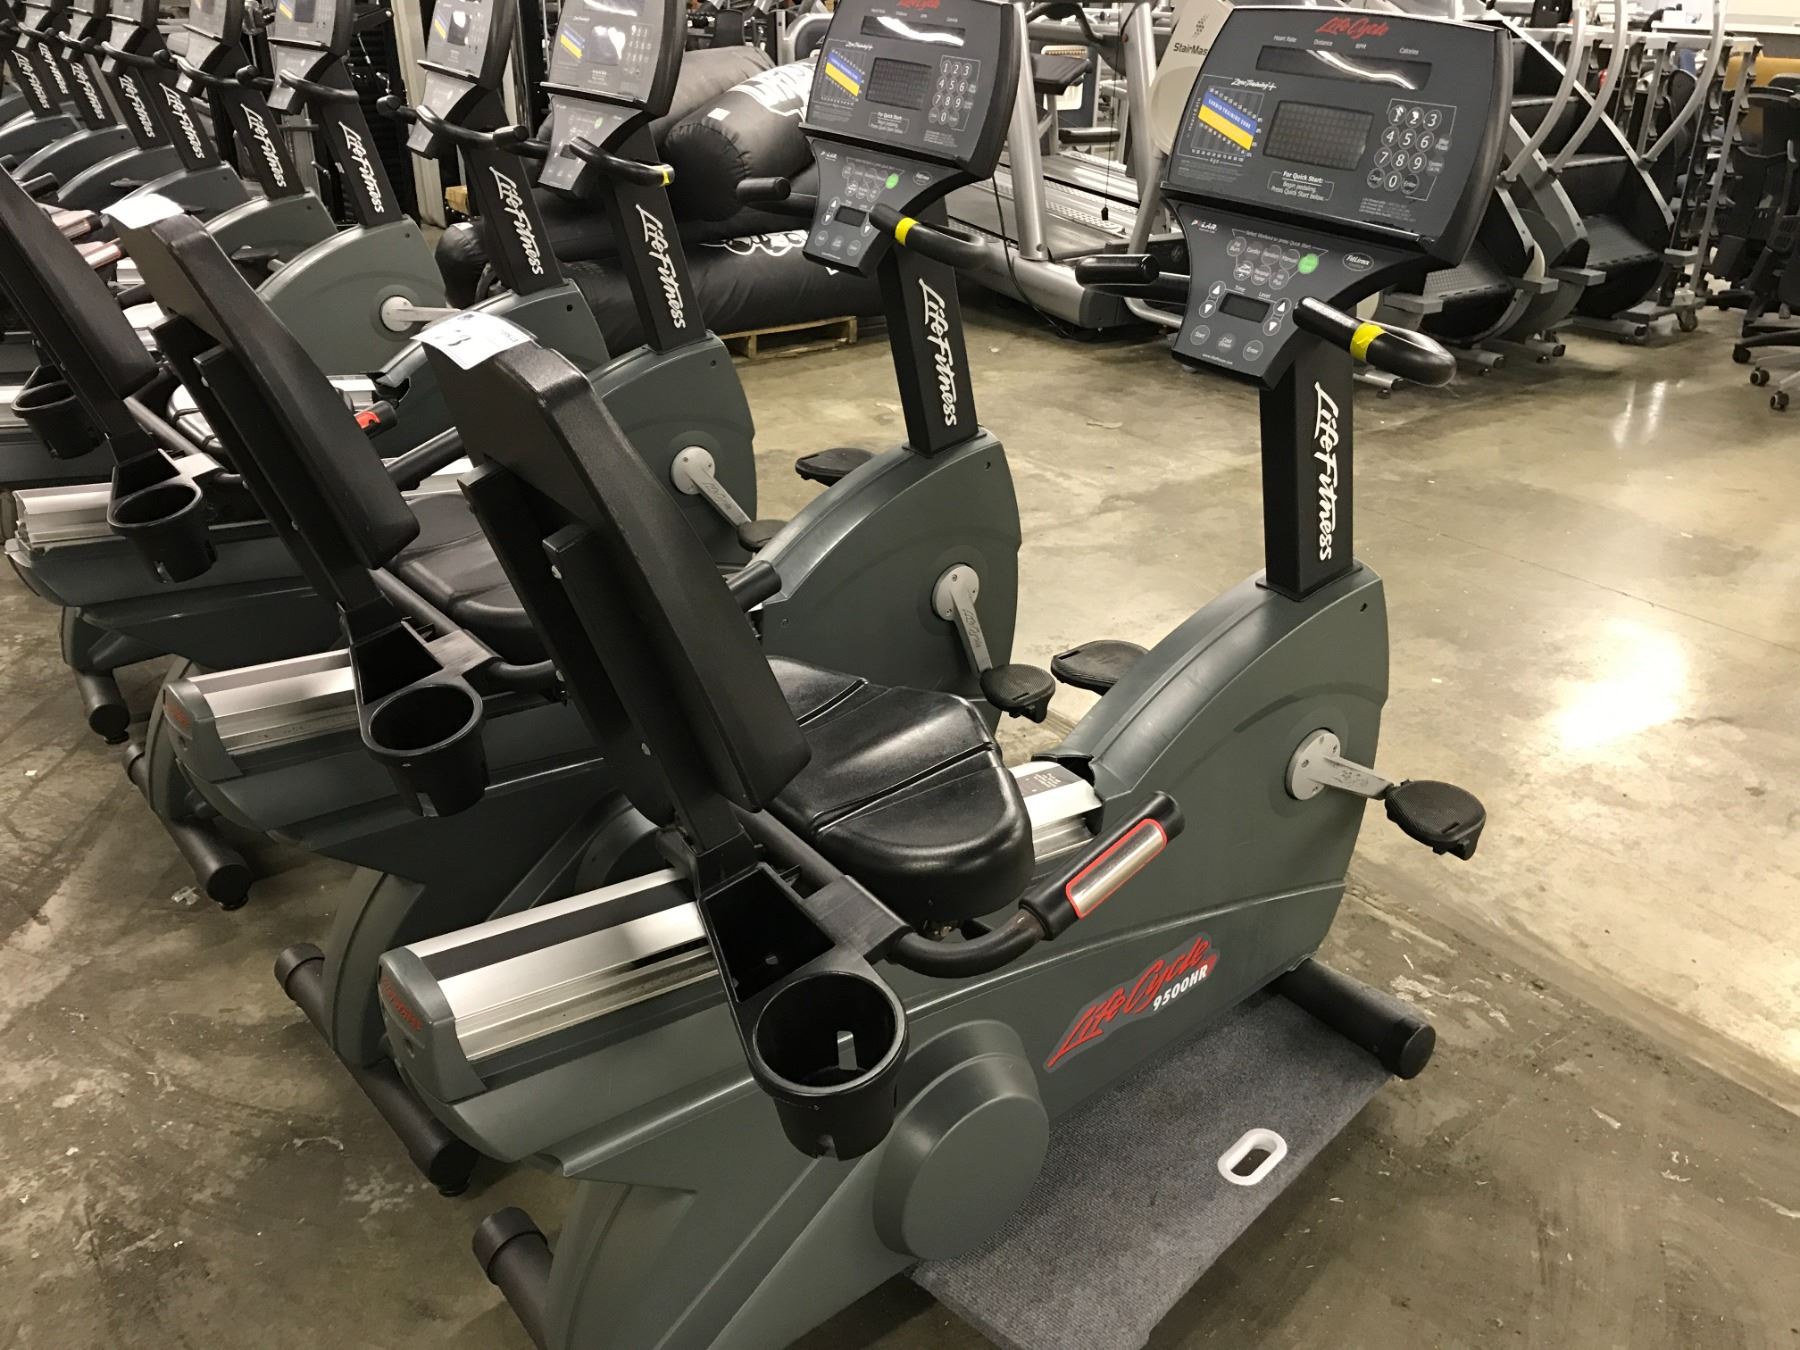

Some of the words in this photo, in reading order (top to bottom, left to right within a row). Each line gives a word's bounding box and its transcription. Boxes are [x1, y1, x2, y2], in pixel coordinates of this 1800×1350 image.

[943, 63, 949, 73] 1
[952, 64, 959, 74] 2
[963, 65, 969, 75] 3
[938, 79, 945, 88] 4
[949, 80, 955, 90] 5
[959, 82, 966, 92] 6
[935, 95, 941, 104] 7
[945, 96, 951, 106] 8
[955, 98, 961, 108] 9
[940, 112, 946, 122] 0
[1410, 111, 1419, 124] 2
[1427, 113, 1437, 126] 3
[1386, 131, 1395, 143] 4
[1403, 133, 1412, 146] 5
[1420, 135, 1430, 148] 6
[1380, 151, 1389, 163] 7
[1395, 154, 1404, 167] 8
[1413, 157, 1422, 169] 9
[1293, 172, 1307, 181] Quick
[1388, 175, 1398, 188] 0
[1153, 964, 1208, 1011] 9500HR
